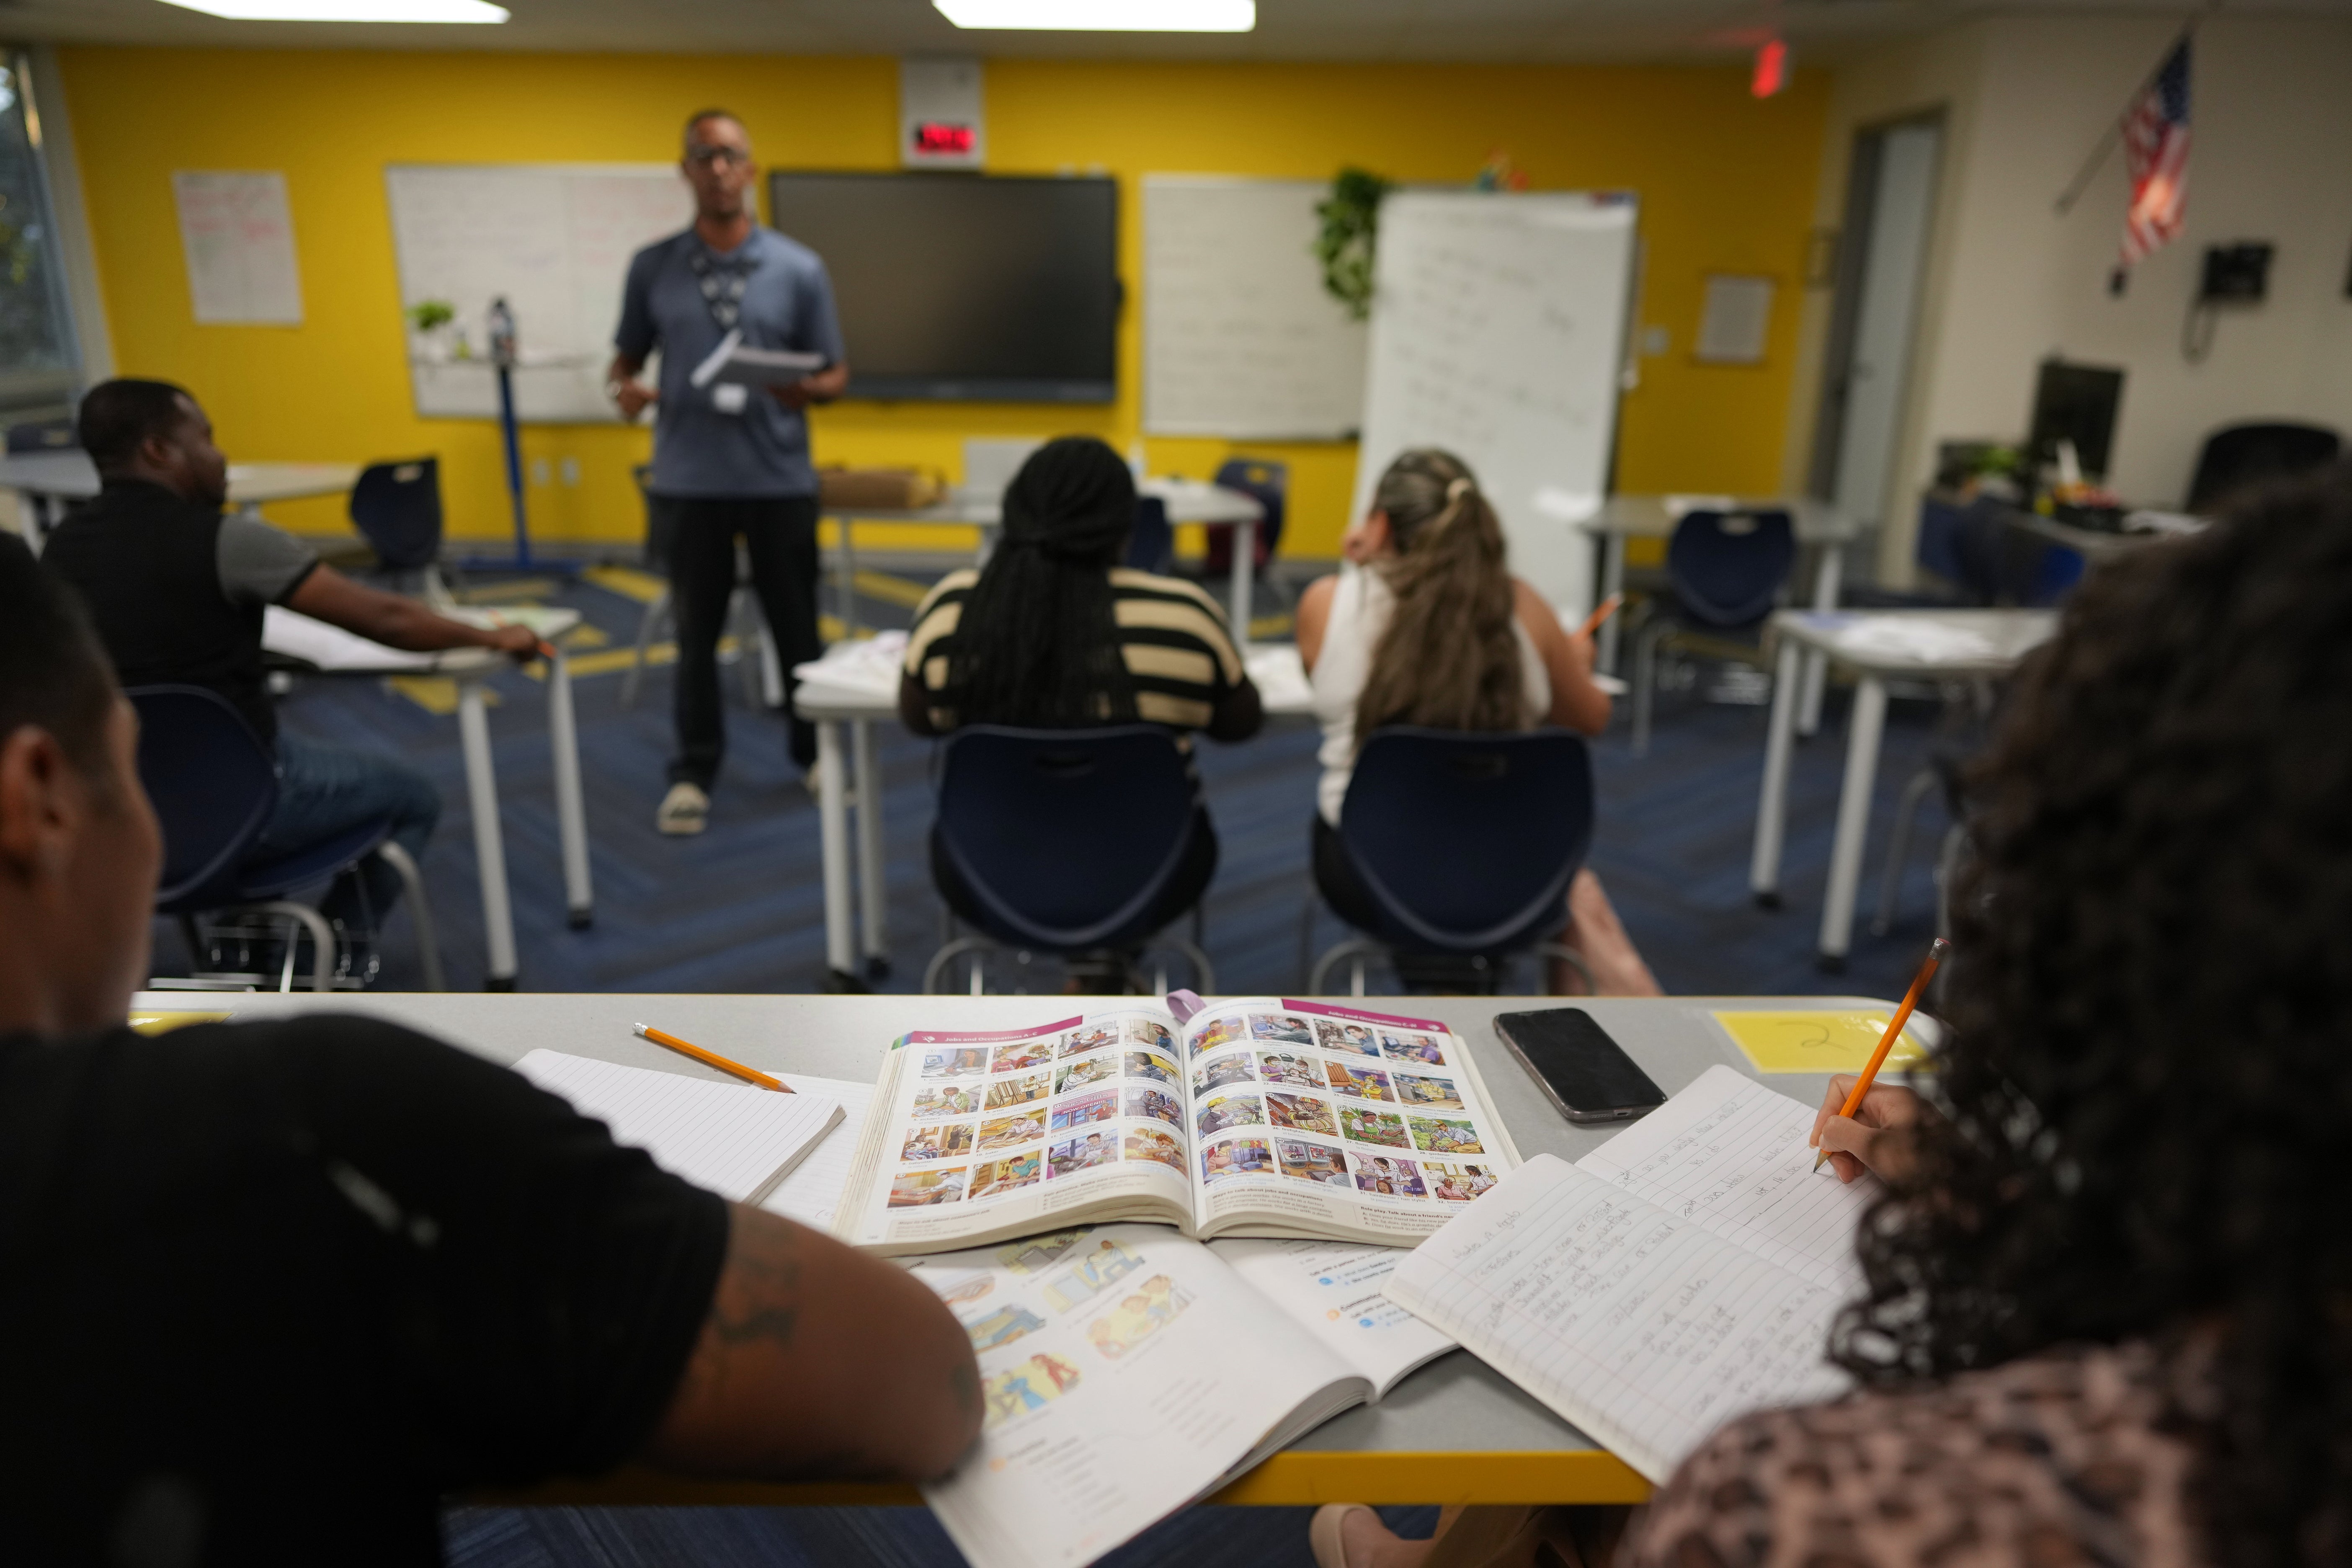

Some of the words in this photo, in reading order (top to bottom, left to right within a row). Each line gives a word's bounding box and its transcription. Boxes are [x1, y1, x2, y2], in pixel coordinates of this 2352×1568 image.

[1359, 1016, 1402, 1026] Occupations
[1777, 1020, 1850, 1052] 2
[1063, 1087, 1086, 1096] assembler
[1202, 1088, 1218, 1098] delivery
[1206, 1089, 1226, 1099] repartidor
[1063, 1099, 1084, 1109] Sue's
[1086, 1093, 1108, 1102] Gifts
[1080, 1100, 1104, 1112] OPEN!!!
[1135, 1117, 1172, 1127] businessperson
[1207, 1130, 1227, 1139] engineer
[1658, 1153, 1669, 1165] you
[1213, 1175, 1234, 1184] garment
[1290, 1192, 1323, 1201] occupations
[1703, 1191, 1724, 1202] Does
